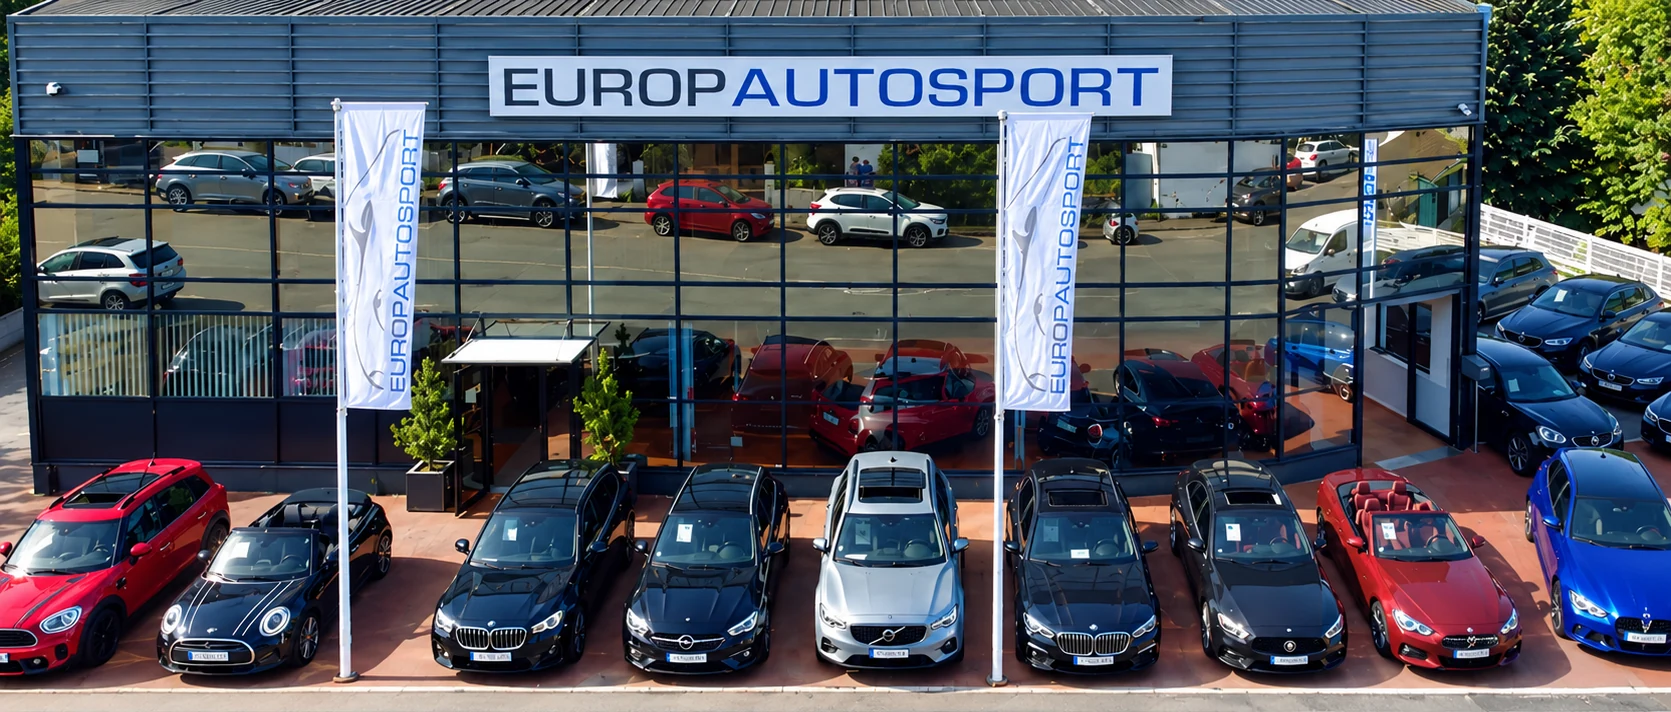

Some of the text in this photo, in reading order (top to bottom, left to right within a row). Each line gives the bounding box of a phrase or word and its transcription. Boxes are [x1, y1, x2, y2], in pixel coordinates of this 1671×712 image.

[504, 67, 1159, 107] EUROPAUTOSPORT
[390, 129, 419, 392] EUROPAUTOSPORT
[1050, 135, 1084, 394] EUROPAUTOSPORT
